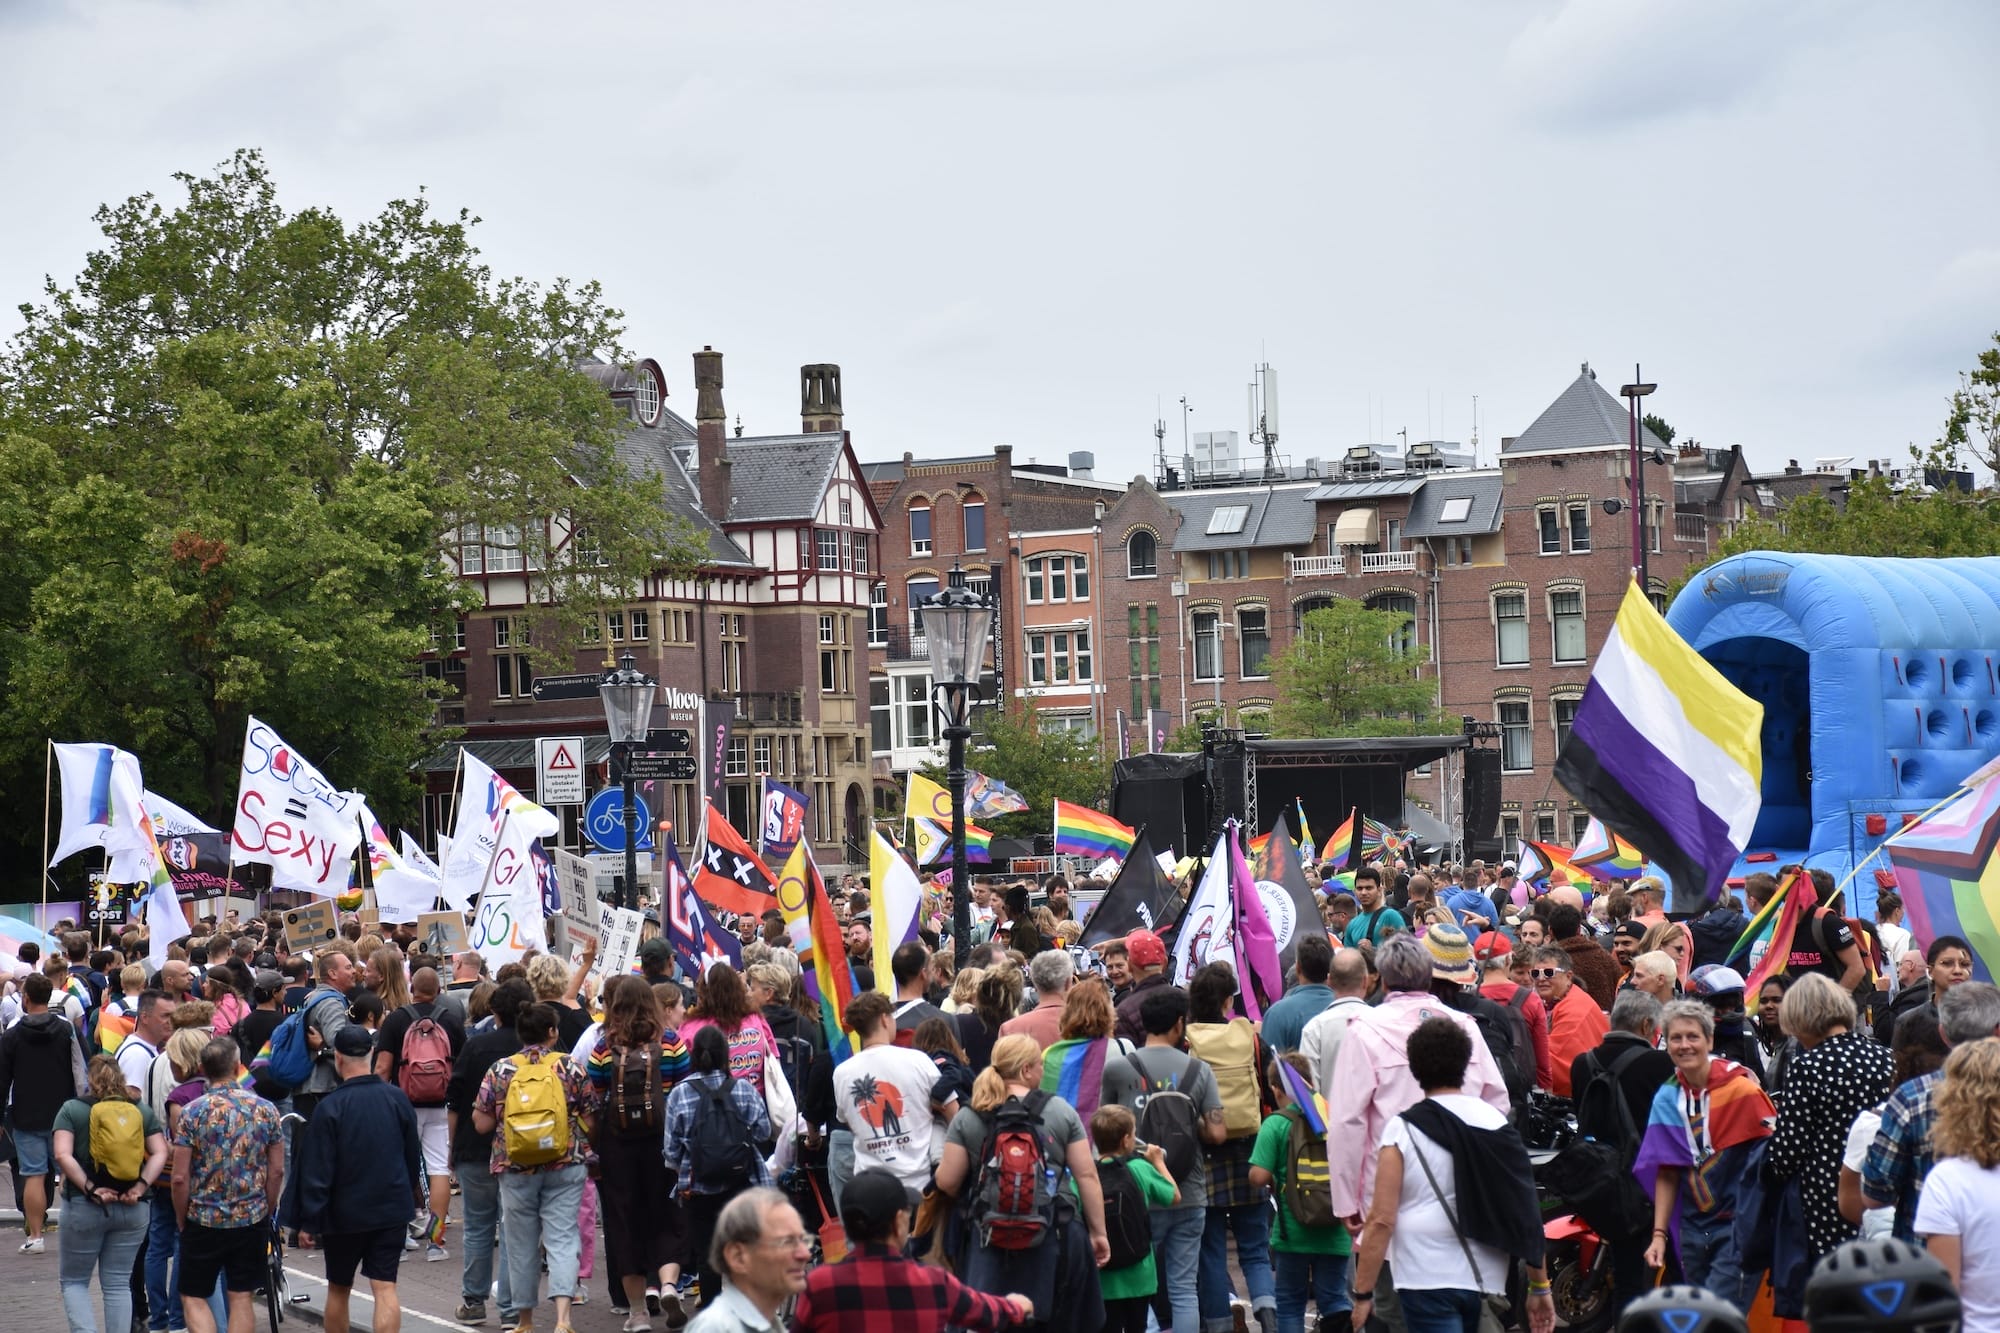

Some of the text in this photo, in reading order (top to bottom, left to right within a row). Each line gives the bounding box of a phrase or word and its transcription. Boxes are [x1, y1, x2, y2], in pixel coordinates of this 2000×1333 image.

[664, 687, 698, 710] Moco
[671, 713, 693, 721] MUSEUM
[233, 791, 337, 883] Sexy
[572, 859, 588, 880] Hen
[574, 878, 586, 899] Hij
[89, 910, 122, 920] OOST
[576, 896, 588, 917] Zij
[601, 909, 615, 929] He
[625, 915, 638, 934] Hen
[619, 935, 631, 956] Hij
[867, 1139, 893, 1151] SURF
